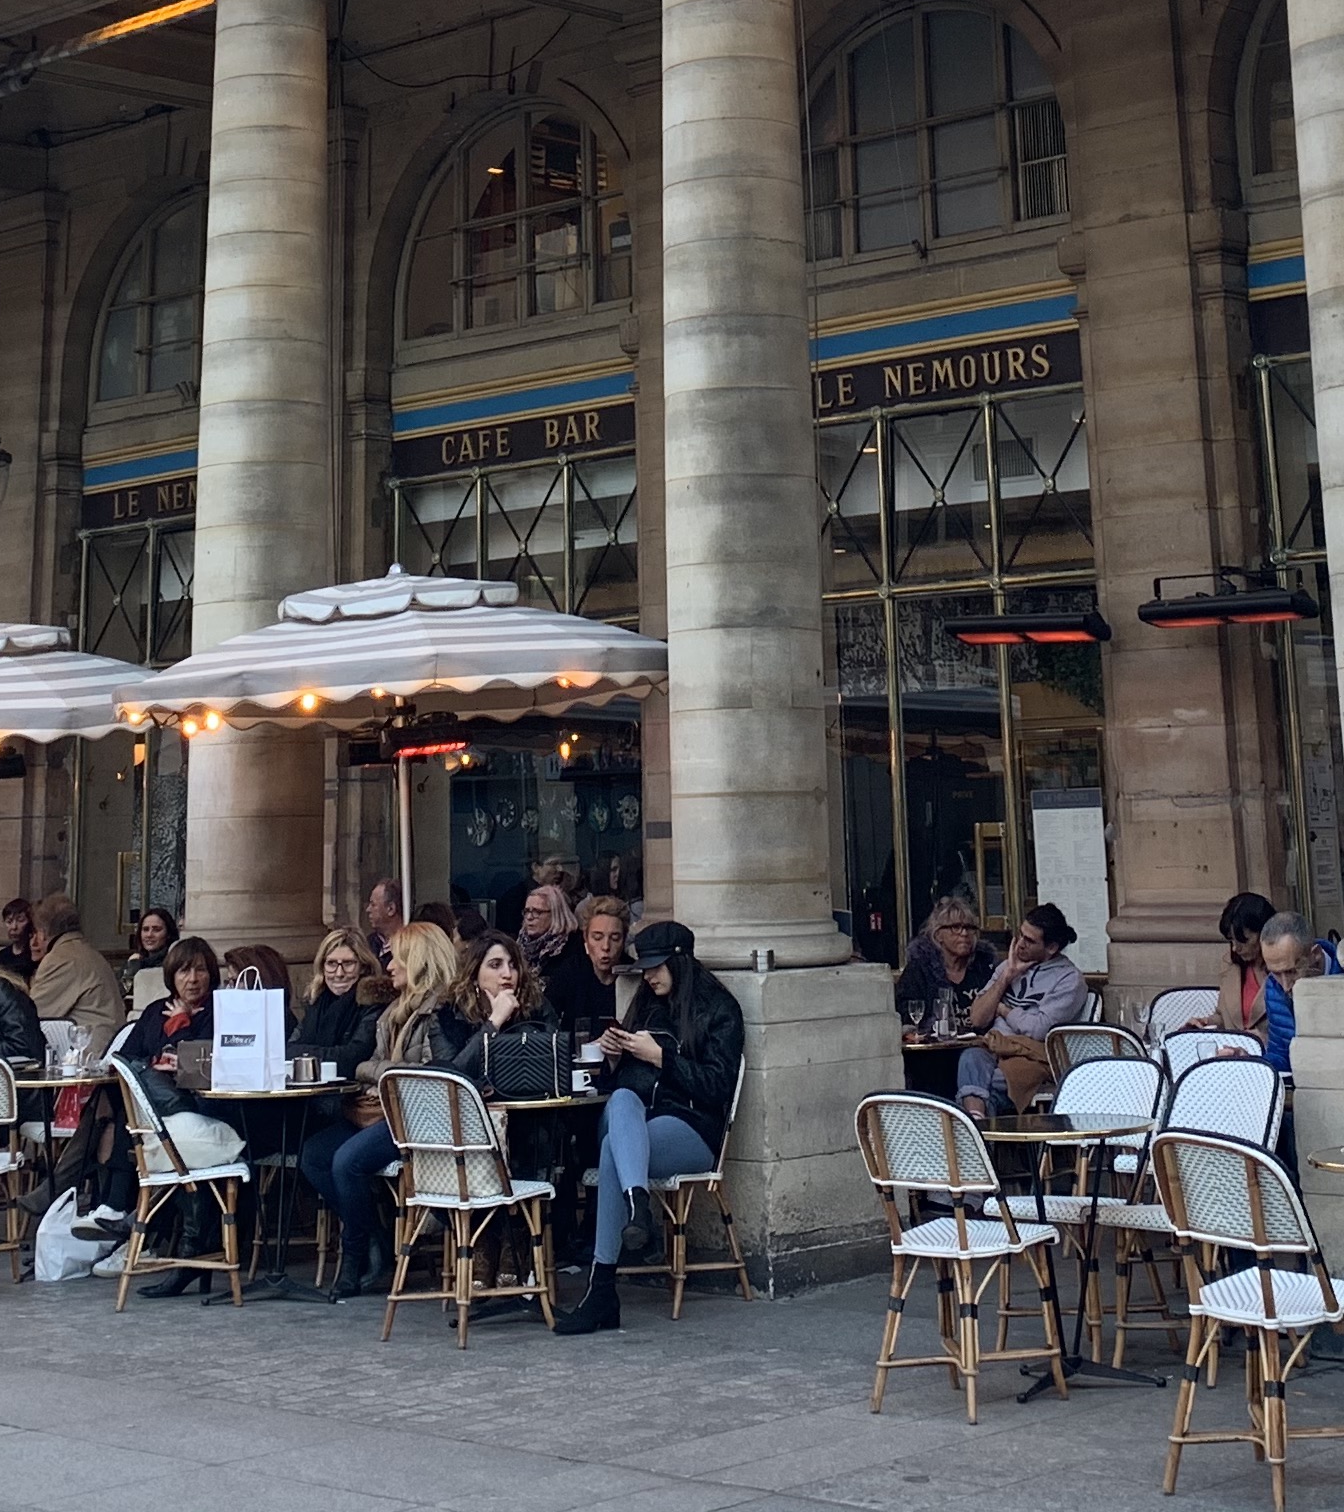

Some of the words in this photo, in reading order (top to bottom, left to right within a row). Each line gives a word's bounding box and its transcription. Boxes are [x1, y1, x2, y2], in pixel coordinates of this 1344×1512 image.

[818, 374, 856, 409] LE
[883, 343, 1052, 399] NEMOURS
[441, 427, 511, 465] CAFE
[543, 411, 601, 449] BAR
[113, 490, 140, 519] LE
